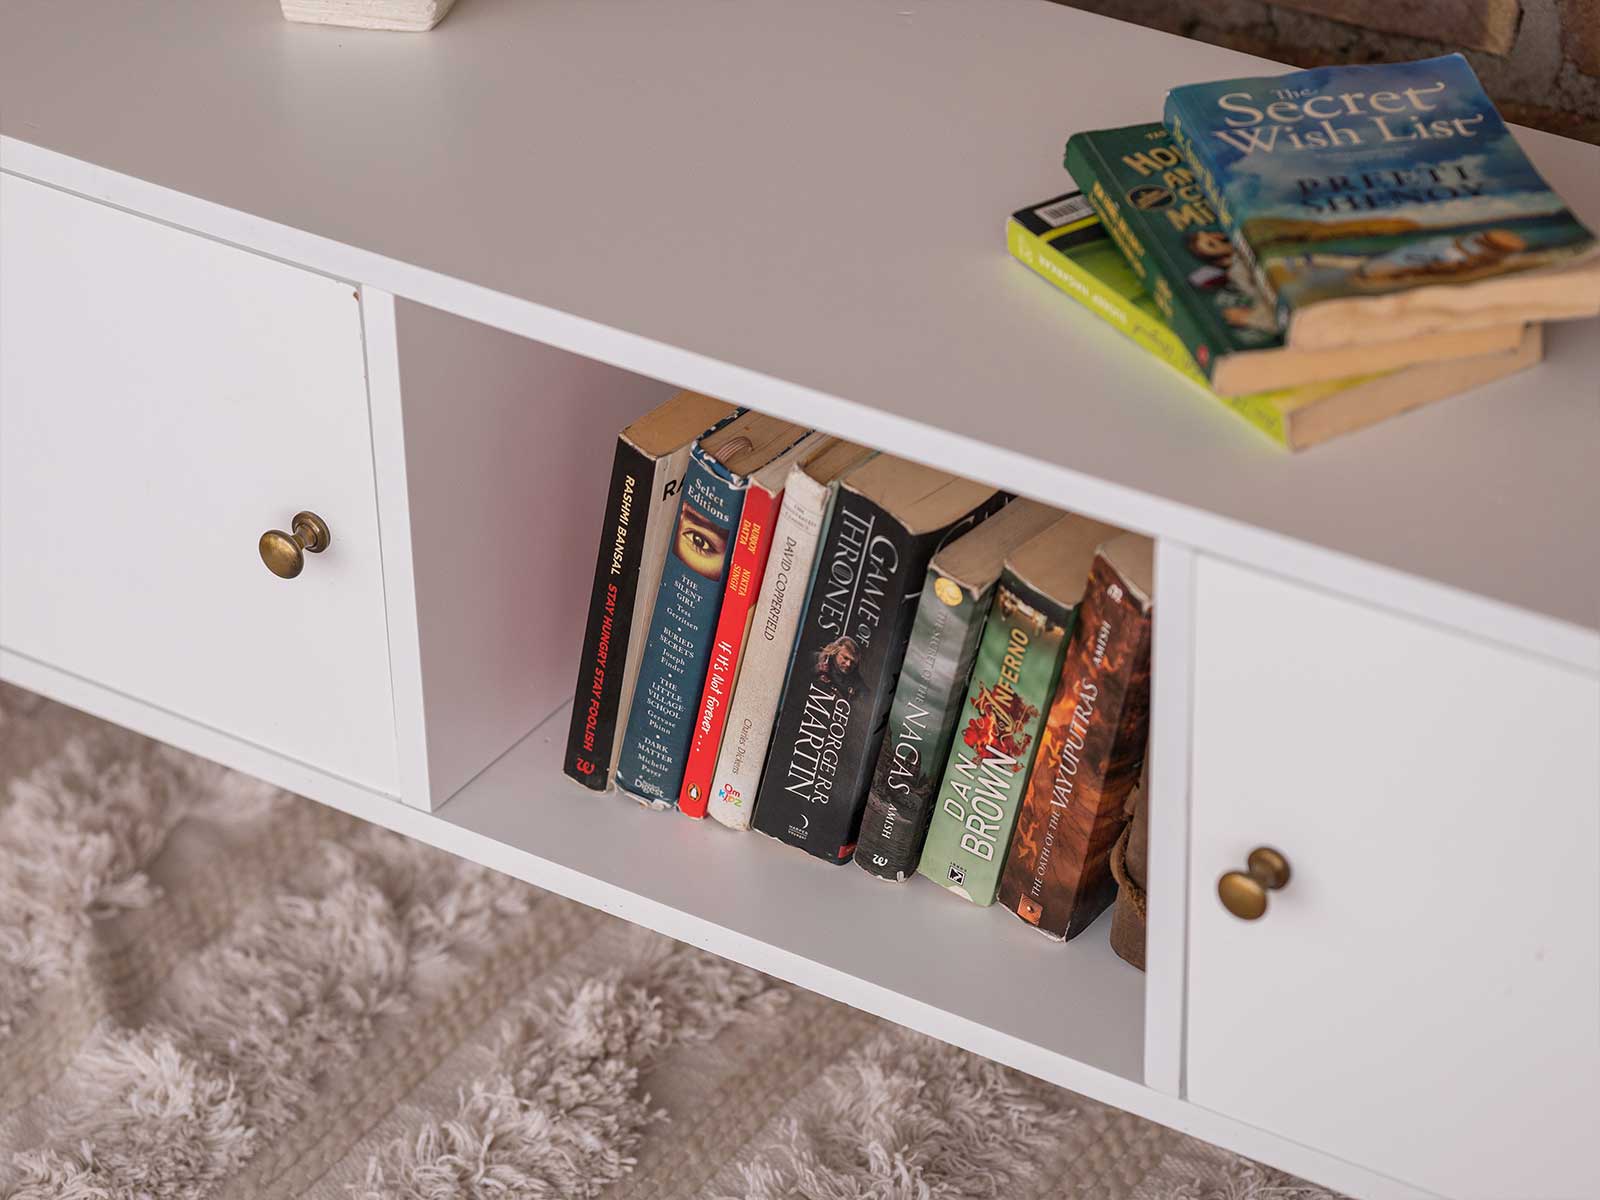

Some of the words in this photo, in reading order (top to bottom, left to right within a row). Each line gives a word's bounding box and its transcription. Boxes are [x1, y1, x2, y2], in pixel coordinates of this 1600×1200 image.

[1217, 81, 1445, 128] Secret
[1212, 119, 1363, 155] Wish
[1370, 113, 1484, 143] List
[619, 474, 636, 526] RASHMI
[688, 485, 729, 522] Editions
[695, 478, 724, 507] Select
[739, 520, 751, 545] DATTA
[610, 526, 627, 575] BANSAL
[782, 536, 797, 572] DAVID
[681, 575, 698, 591] THE
[729, 564, 741, 592] SINGH
[738, 568, 751, 596] NIKITA
[818, 506, 875, 638] THRONES
[857, 535, 899, 627] GAME
[603, 583, 618, 618] STAY
[674, 580, 703, 602] SILENT
[676, 592, 695, 609] GIRL
[676, 604, 691, 618] Tess
[764, 571, 789, 641] COPPERFIELD
[596, 617, 614, 668] HUNGRY
[660, 634, 694, 658] SECRETS
[663, 626, 694, 649] BURIED
[856, 623, 872, 648] OF
[1093, 620, 1112, 669] AMISH
[661, 657, 684, 674] Finder
[662, 648, 686, 667] Joseph
[592, 667, 605, 696] STAY
[652, 682, 682, 703] LITTLE
[660, 677, 677, 692] THE
[710, 673, 725, 695] Not
[973, 628, 1029, 733] INFERNO
[647, 698, 681, 719] SCHOOL
[648, 688, 684, 712] VILLAGE
[583, 696, 600, 752] FOOLISH
[649, 719, 671, 735] Phinn
[738, 718, 753, 746] Charles
[820, 698, 851, 777] GEORGE
[637, 742, 673, 764] MATTER
[644, 737, 669, 753] DARK
[785, 683, 836, 802] MARTIN
[887, 702, 930, 795] NAGAS
[1050, 677, 1098, 809] VAYUPUTRAS
[731, 744, 746, 775] Dickens
[944, 752, 978, 822] DAN
[960, 745, 1018, 861] BROWN
[881, 803, 898, 840] AMISH
[1051, 811, 1061, 831] THE
[1046, 830, 1056, 847] OF
[1038, 848, 1051, 879] OATH
[1031, 879, 1043, 898] THE
